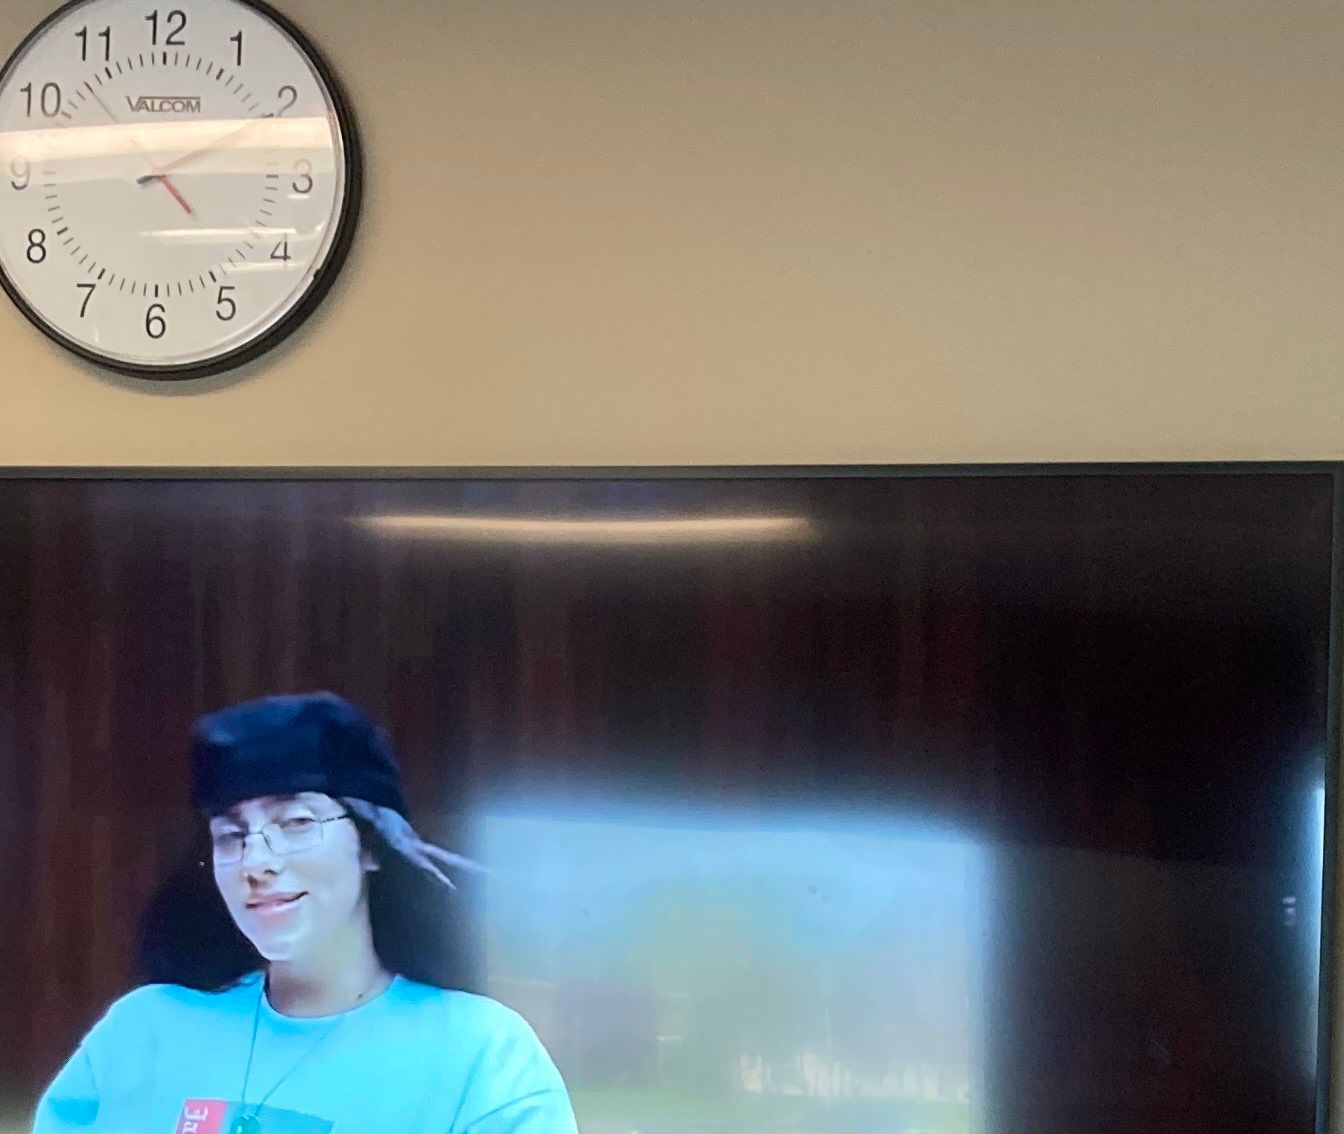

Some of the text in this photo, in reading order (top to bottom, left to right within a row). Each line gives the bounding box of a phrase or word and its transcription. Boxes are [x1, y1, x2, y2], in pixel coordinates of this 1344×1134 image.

[74, 25, 111, 62] 11
[145, 10, 186, 46] 12
[229, 31, 243, 66] 1
[20, 82, 62, 118] 10
[125, 96, 201, 113] VALCOM
[277, 85, 299, 119] 2
[10, 155, 31, 191] 9
[292, 158, 313, 194] 3
[26, 228, 47, 264] 8
[270, 232, 292, 267] 4
[76, 284, 97, 318] 7
[215, 286, 237, 321] 5
[145, 304, 166, 339] 6
